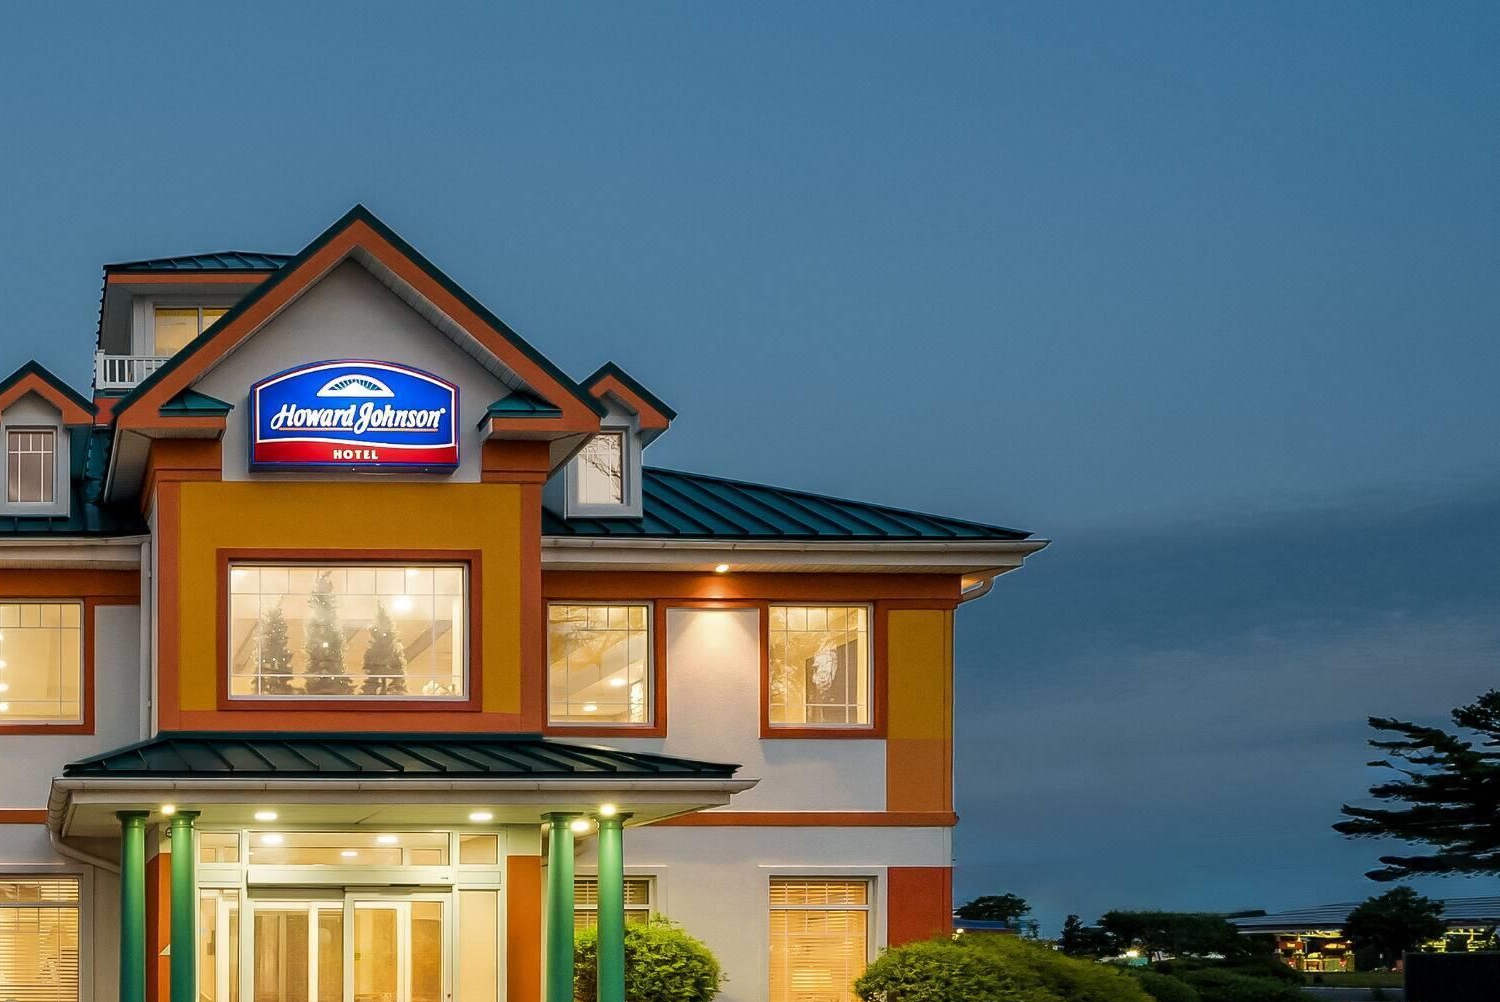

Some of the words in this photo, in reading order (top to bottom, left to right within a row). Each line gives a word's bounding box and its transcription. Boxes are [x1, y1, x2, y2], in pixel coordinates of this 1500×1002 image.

[270, 403, 355, 430] Howard
[353, 402, 441, 435] Johnson
[333, 449, 378, 460] HOTEL
